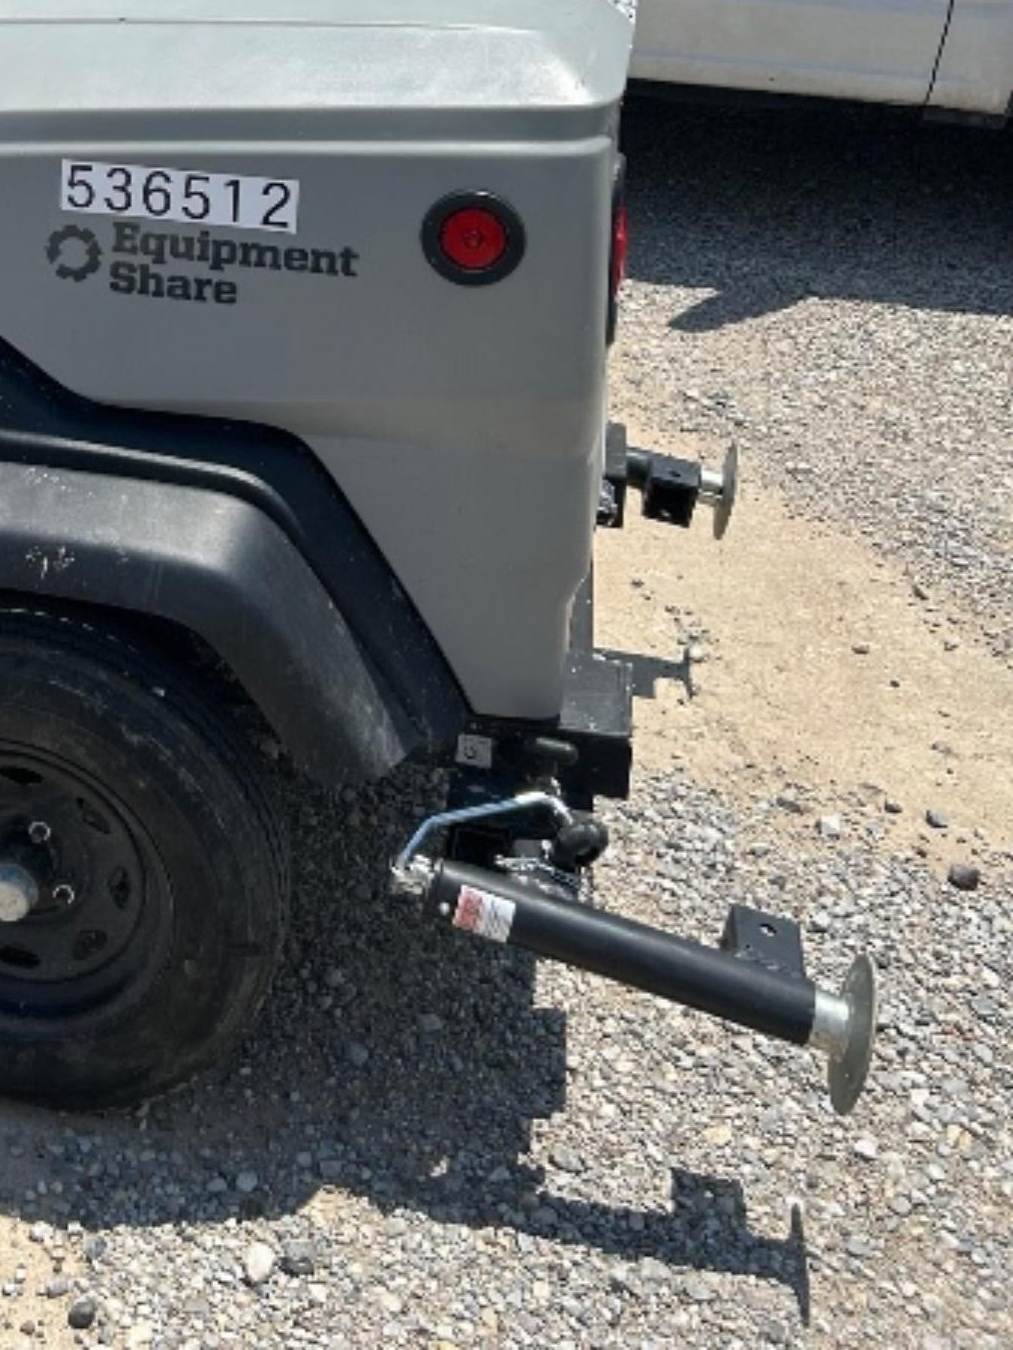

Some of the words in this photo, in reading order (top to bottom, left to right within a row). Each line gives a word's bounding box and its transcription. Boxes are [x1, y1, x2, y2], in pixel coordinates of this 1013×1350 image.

[66, 163, 292, 229] 536512
[111, 221, 361, 278] Equipment
[108, 260, 239, 305] Share
